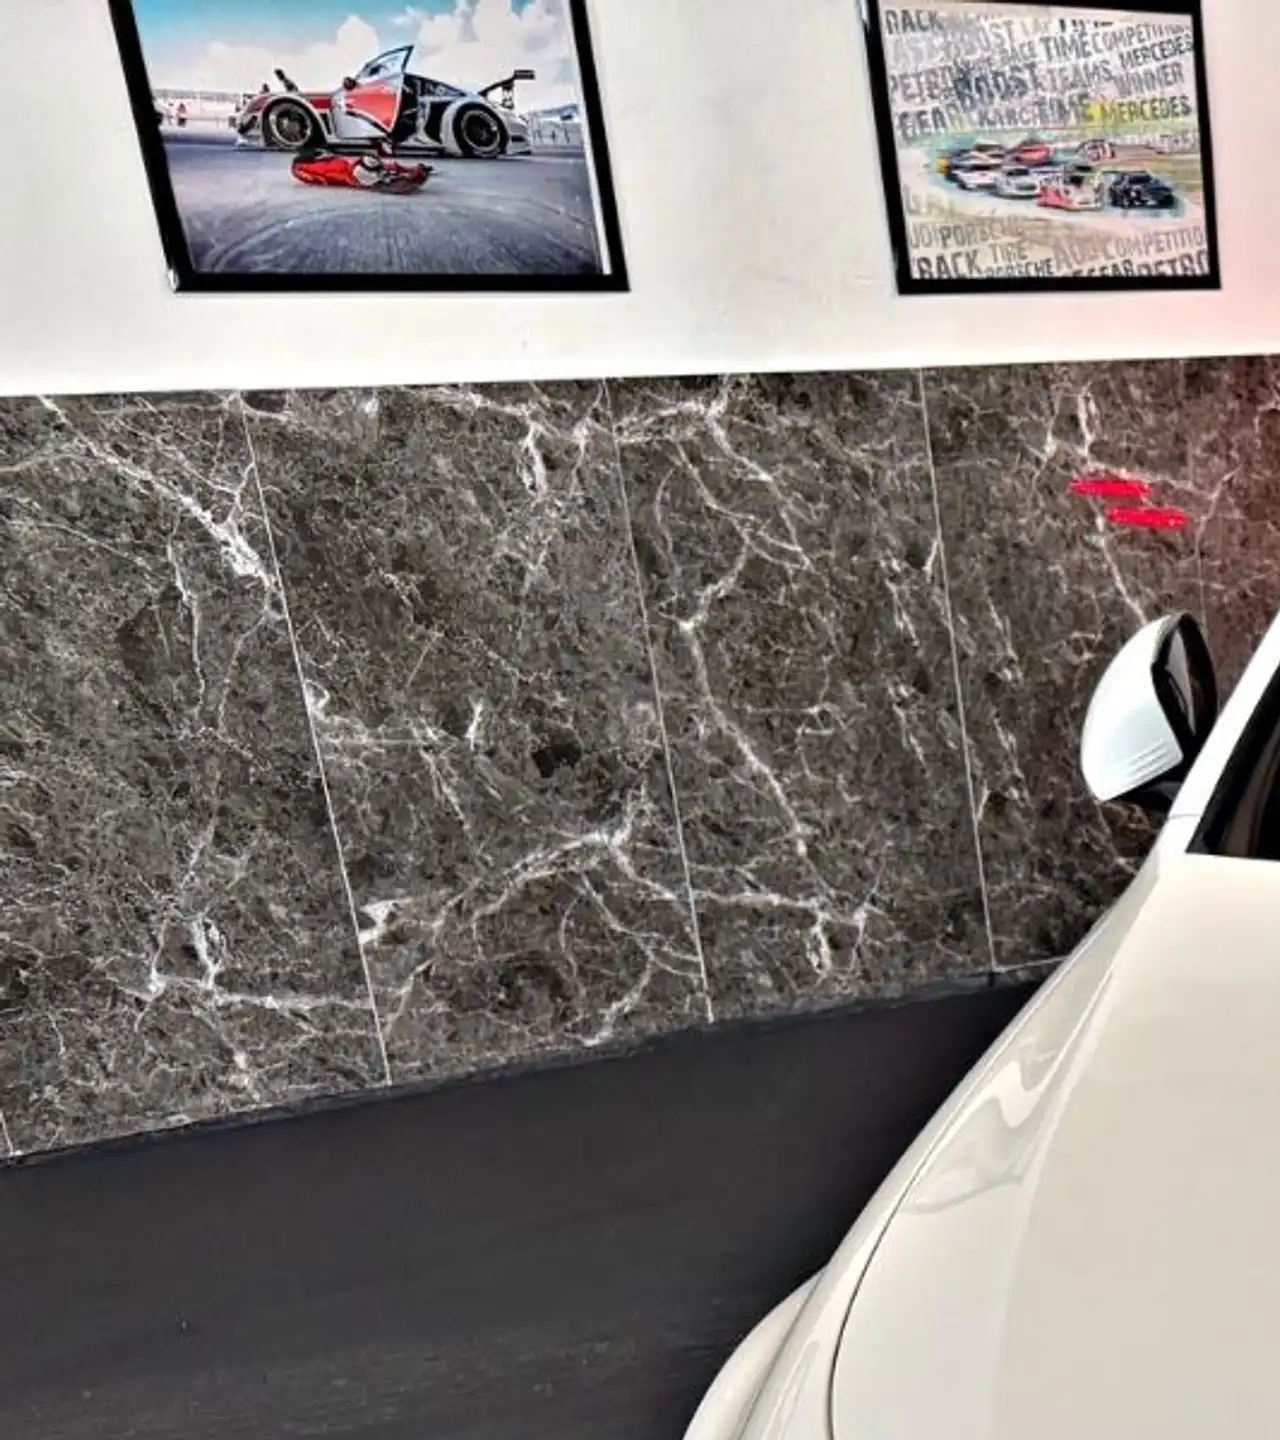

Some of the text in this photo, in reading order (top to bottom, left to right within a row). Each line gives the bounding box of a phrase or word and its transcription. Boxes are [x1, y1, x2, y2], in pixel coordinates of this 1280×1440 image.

[1039, 34, 1092, 62] TIME
[1118, 33, 1194, 69] MERCEDES
[1099, 95, 1192, 125] MERCEDES
